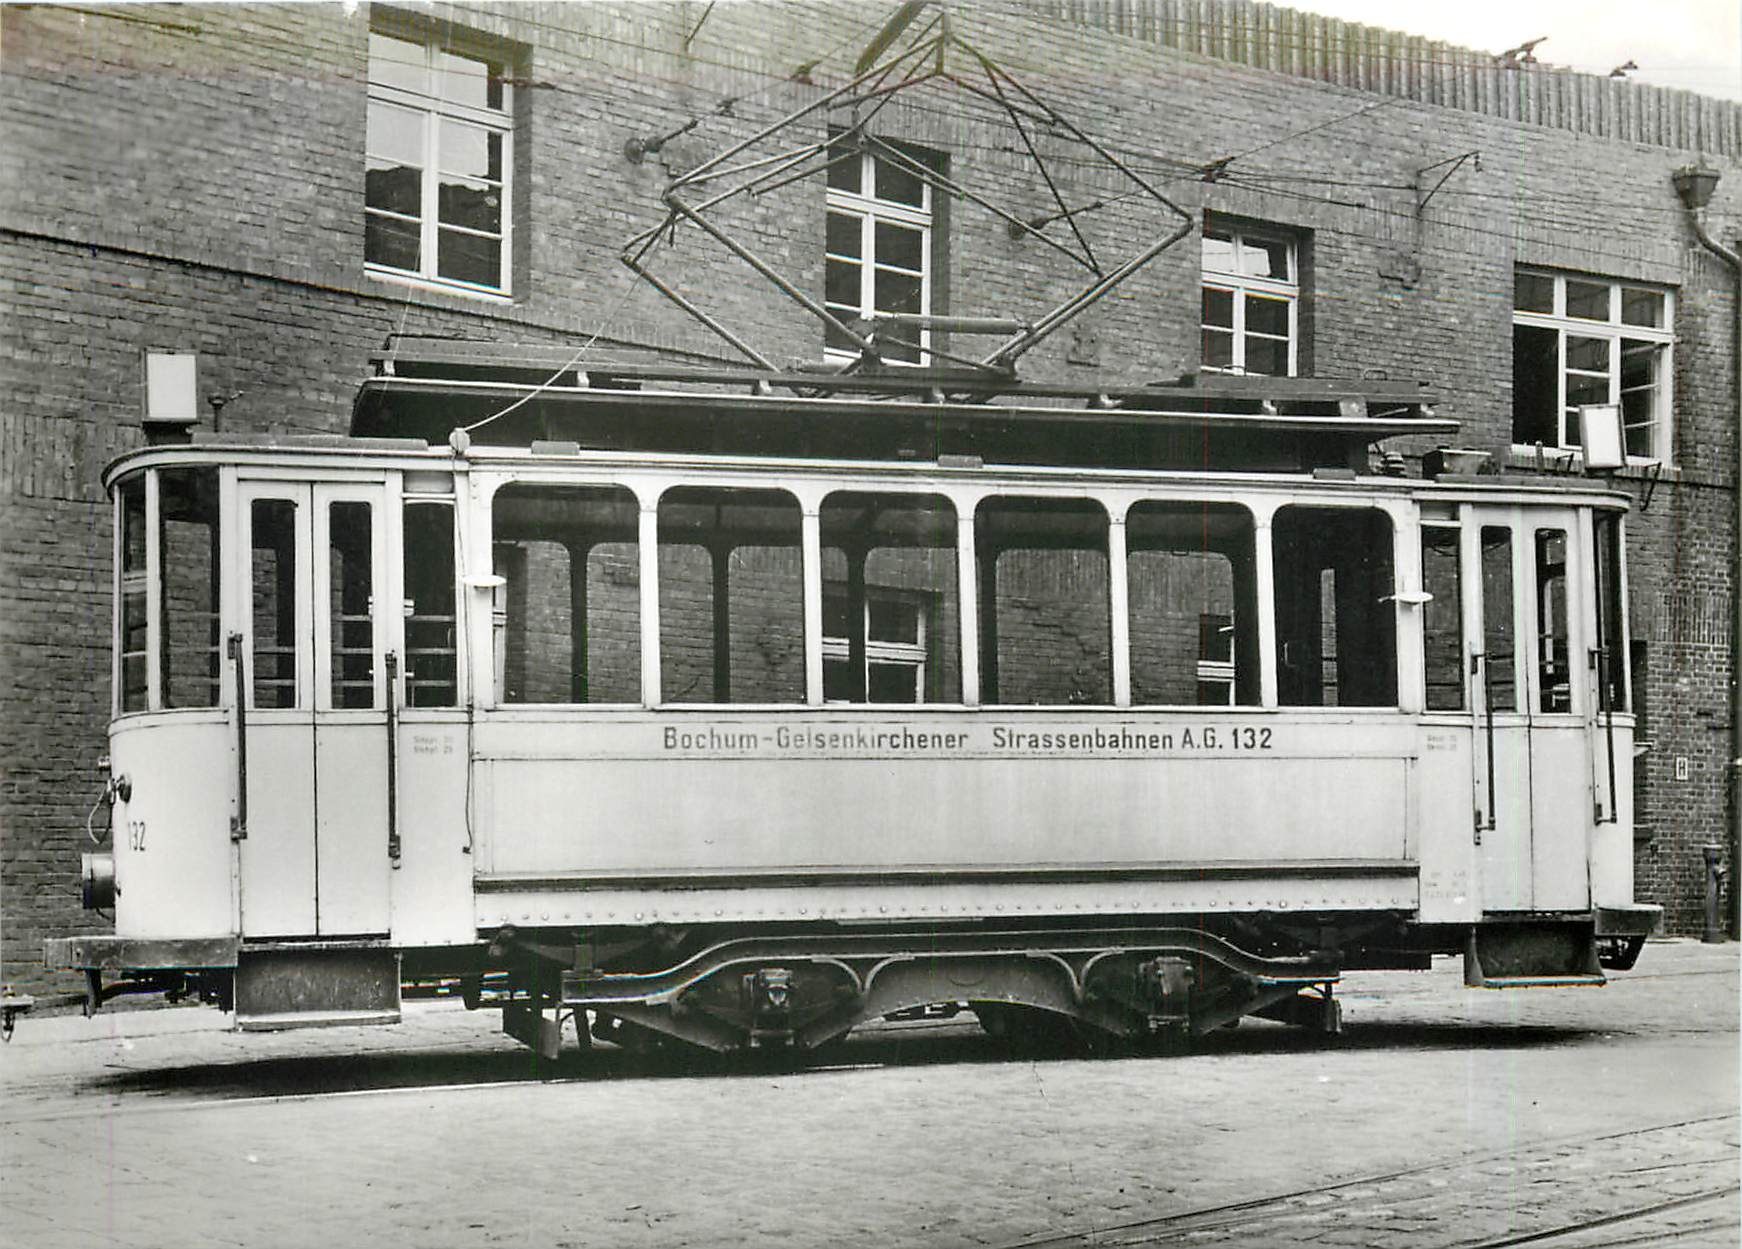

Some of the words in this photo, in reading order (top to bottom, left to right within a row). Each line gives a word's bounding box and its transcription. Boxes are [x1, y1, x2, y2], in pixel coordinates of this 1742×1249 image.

[663, 726, 969, 750] Bochum-Gelsenkirchener
[993, 727, 1174, 750] Strassenbahnen
[1232, 727, 1273, 750] 132
[127, 821, 146, 851] 132
